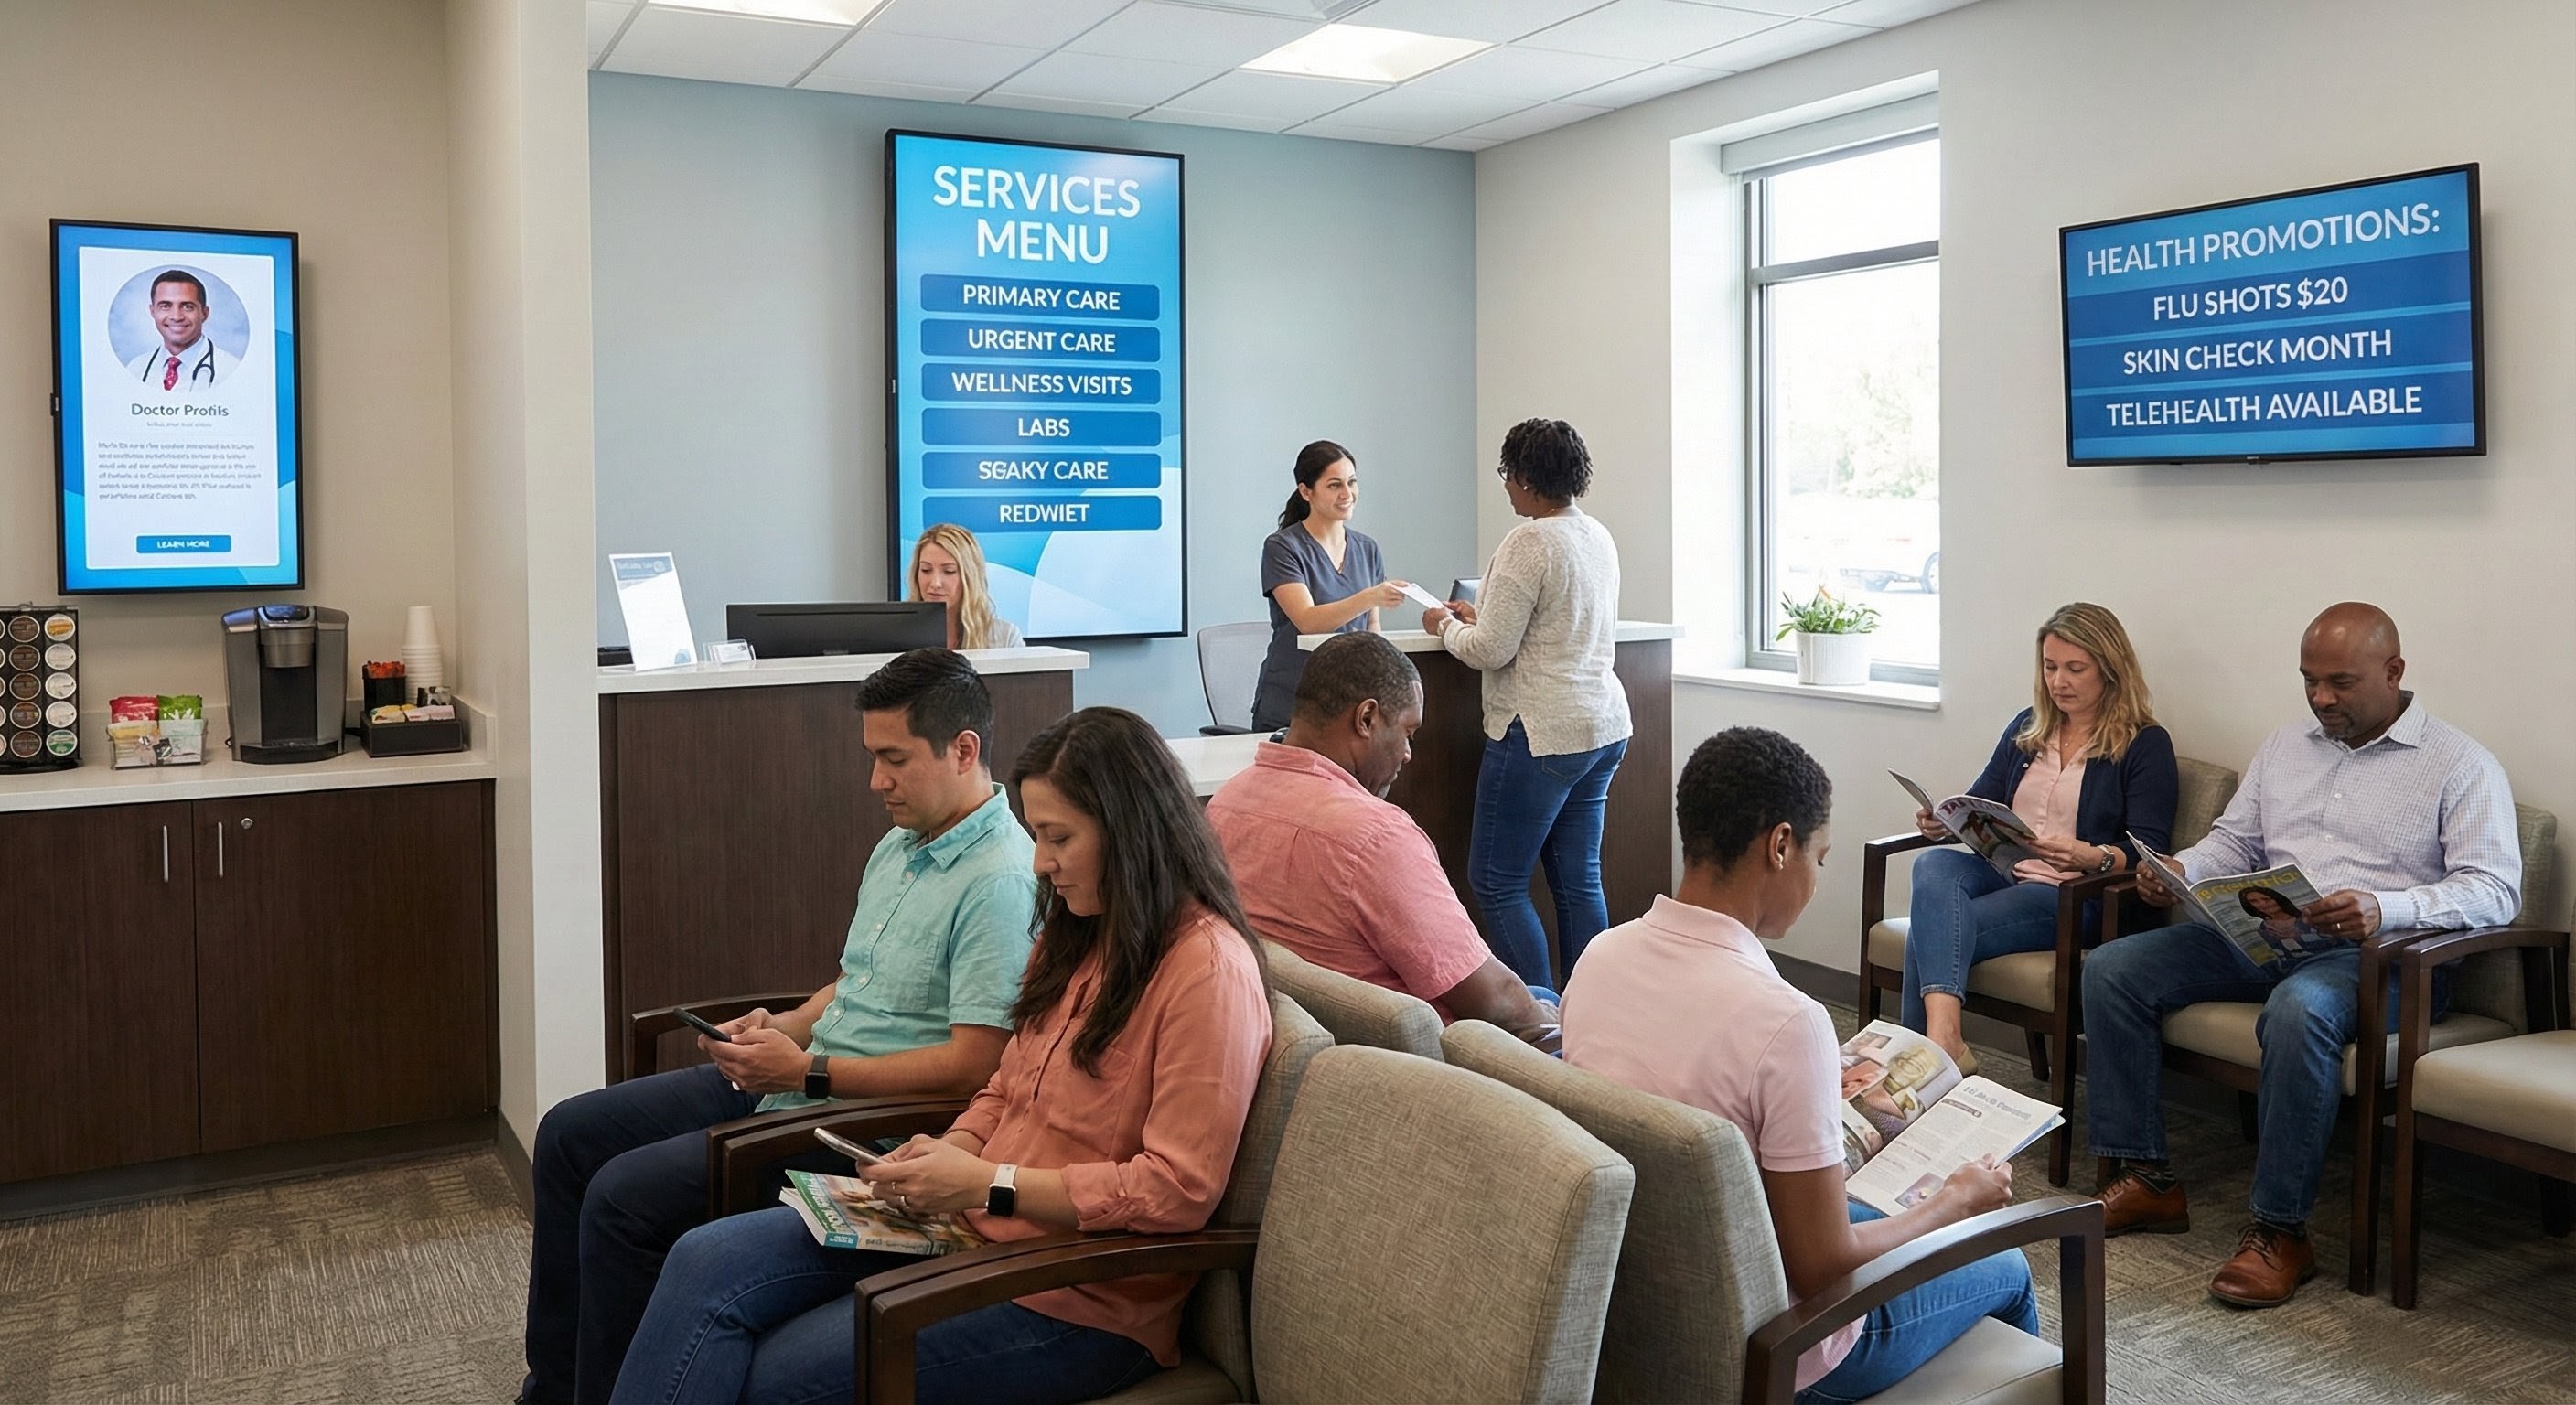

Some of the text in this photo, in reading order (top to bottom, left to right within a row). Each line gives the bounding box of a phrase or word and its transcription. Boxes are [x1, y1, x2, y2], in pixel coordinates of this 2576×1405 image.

[933, 166, 1140, 217] SERVICES
[978, 220, 1107, 263] MENU
[2088, 203, 2440, 276] HEALTH PROMOTIONS:
[964, 284, 1120, 310] PRIMARY CARE
[2154, 277, 2347, 320] FLU SHOTS $20
[969, 329, 1115, 352] URGENT CARE
[2124, 330, 2390, 374] SKIN CHECK MONTH
[952, 373, 1132, 394] WELLNESS VISITS
[132, 403, 180, 416] Doctor
[2107, 387, 2421, 425] TELEHEALTH AVAILABLE
[1019, 418, 1069, 436] LABS
[1054, 462, 1108, 479] CARE
[1000, 504, 1089, 522] REDWIET
